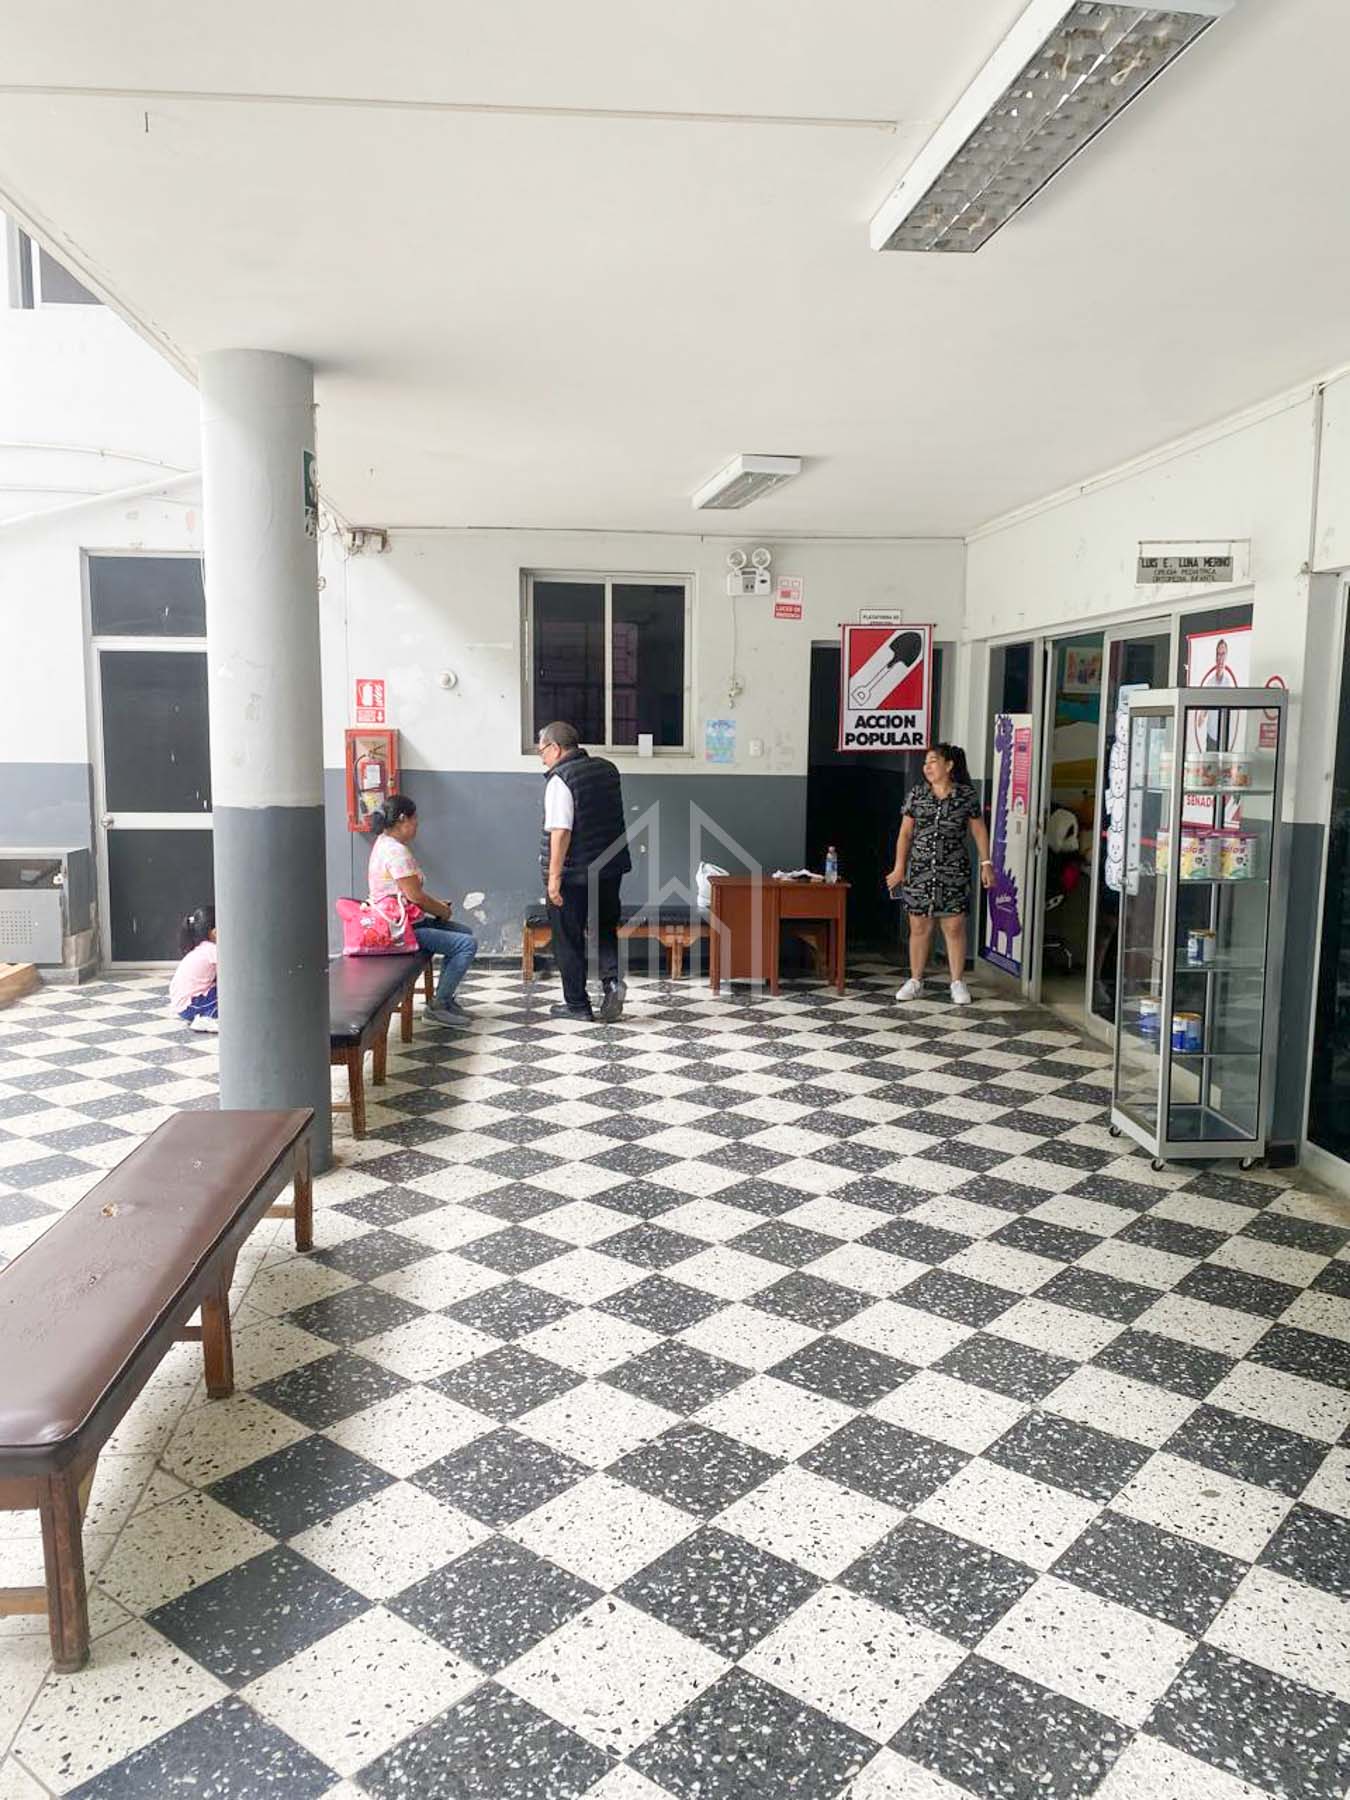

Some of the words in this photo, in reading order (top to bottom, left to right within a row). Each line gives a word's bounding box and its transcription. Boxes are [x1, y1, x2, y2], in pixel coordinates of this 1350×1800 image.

[1179, 557, 1199, 568] LUNA
[855, 715, 916, 729] ACCION
[845, 732, 923, 746] POPULAR
[1187, 793, 1214, 807] SENAD
